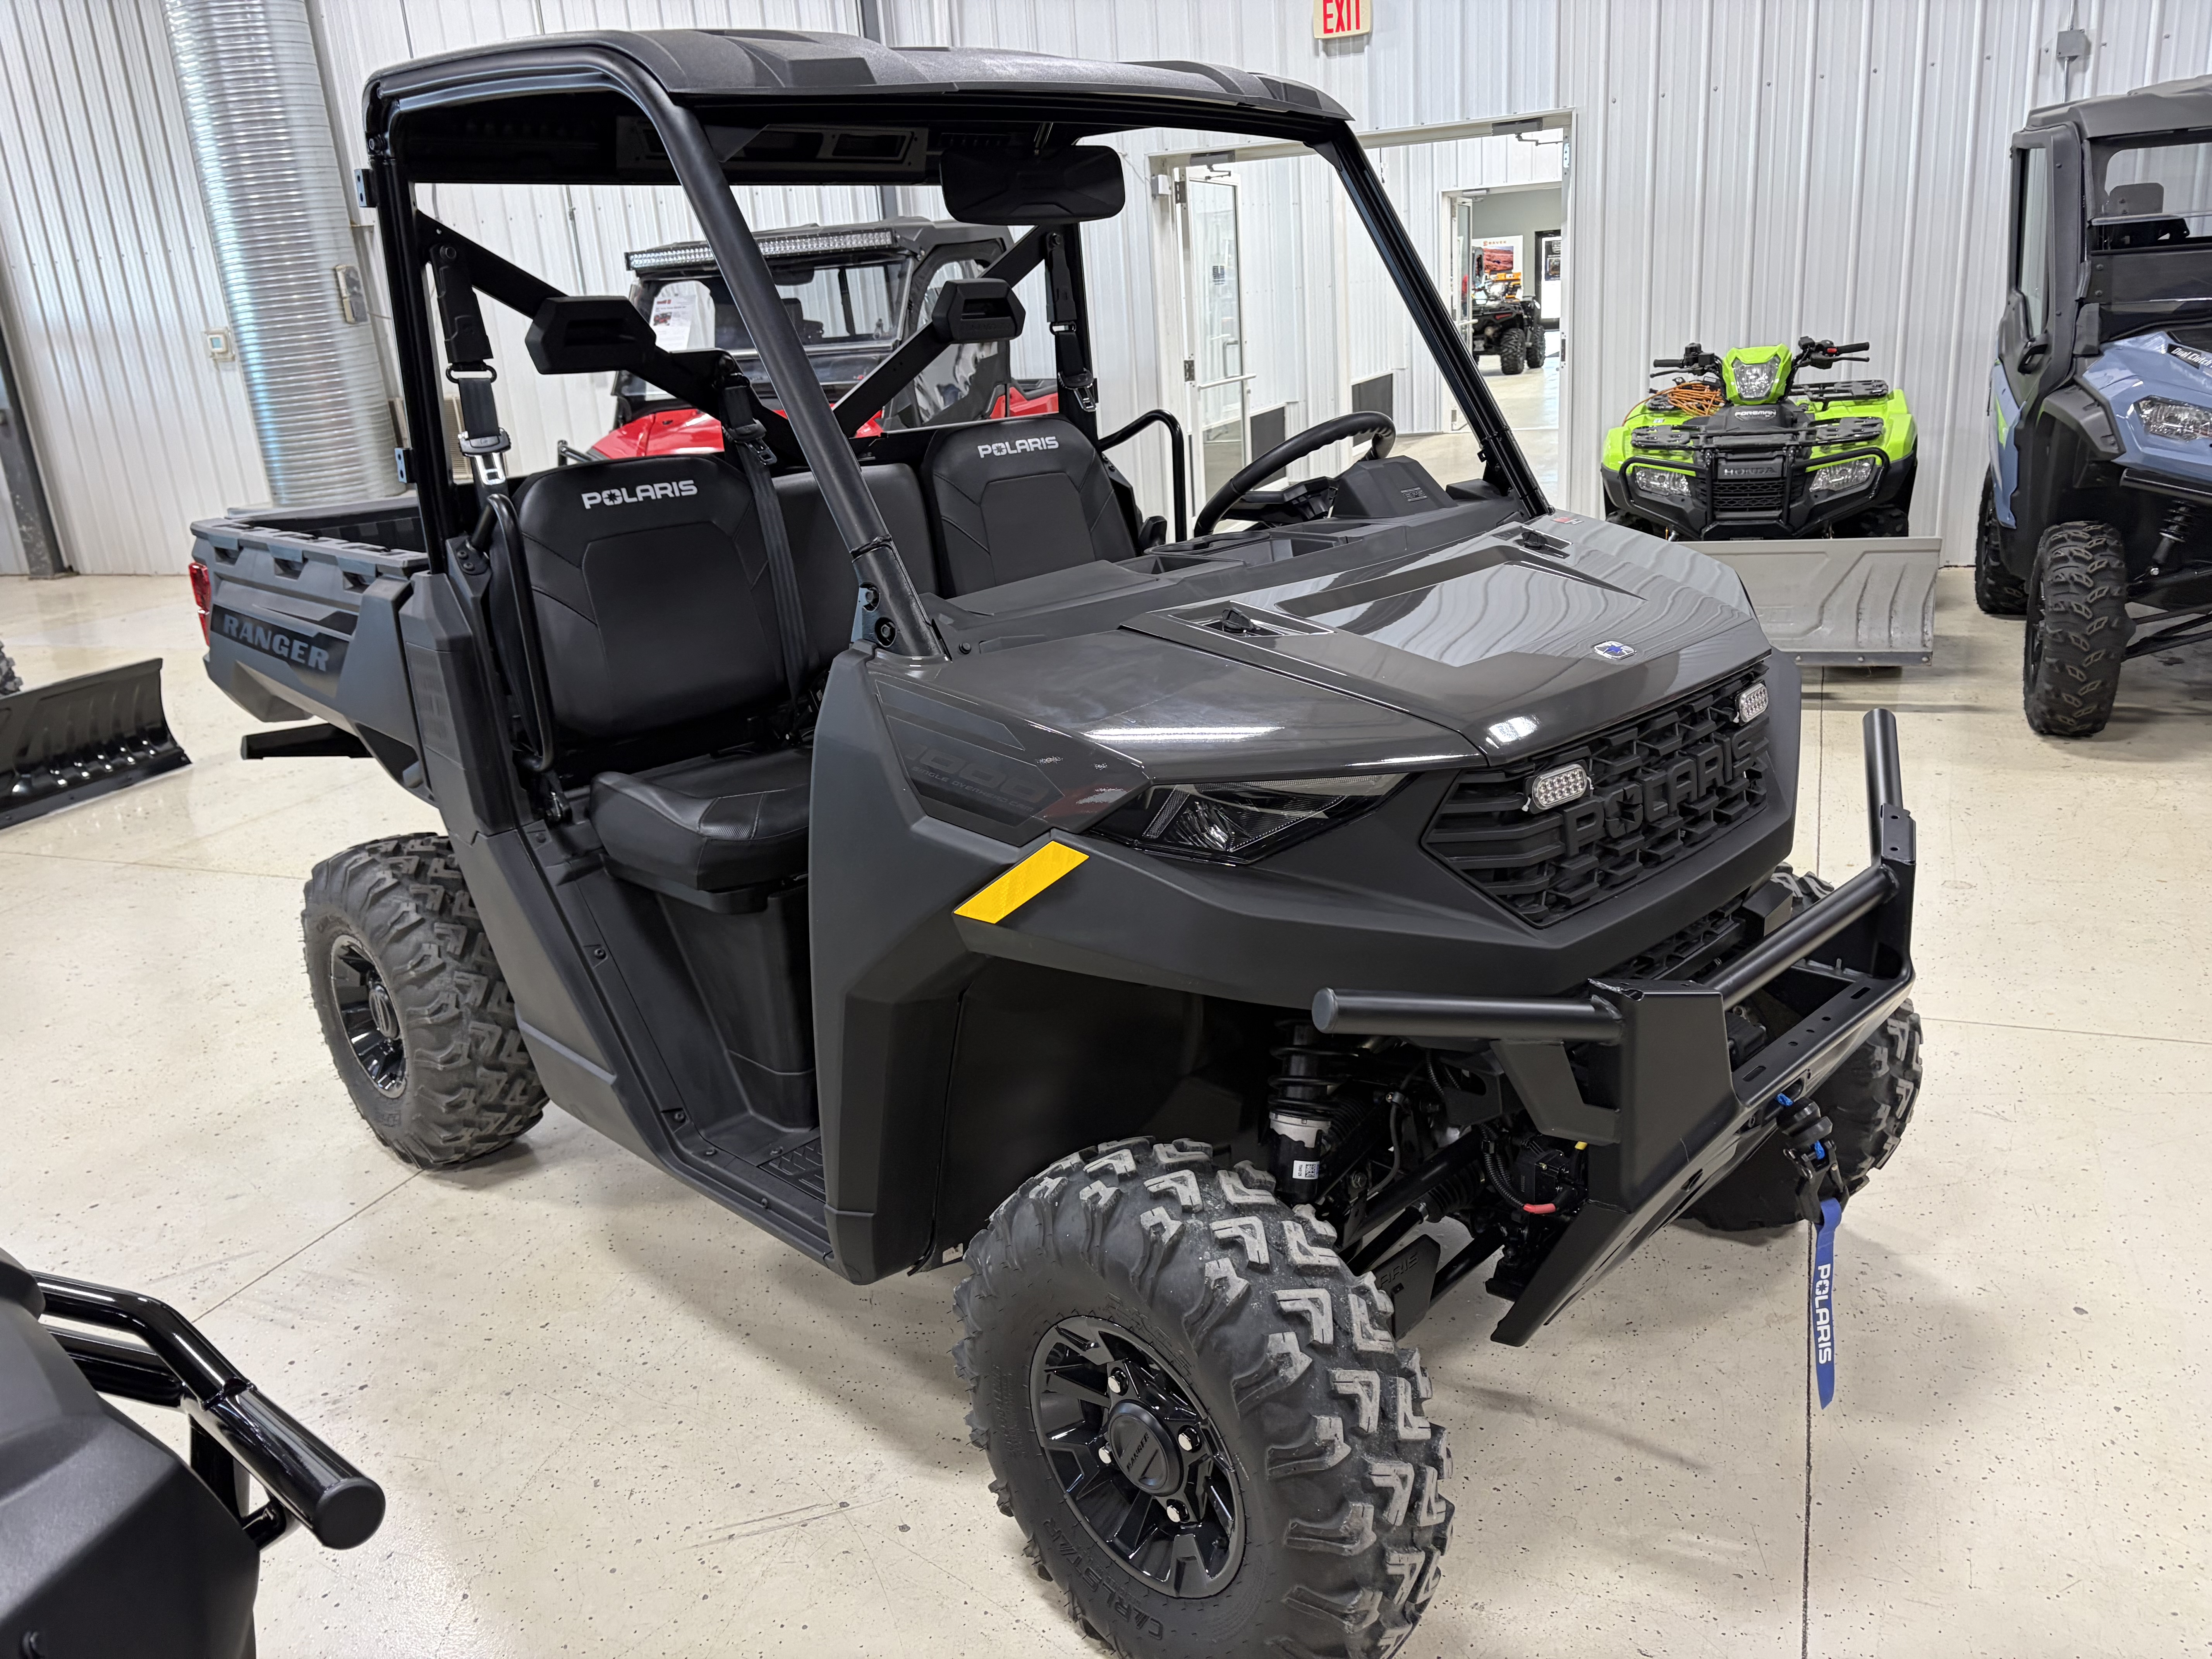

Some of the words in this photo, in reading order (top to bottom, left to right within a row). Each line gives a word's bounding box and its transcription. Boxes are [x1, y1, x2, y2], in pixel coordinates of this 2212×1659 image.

[1323, 0, 1360, 34] EXIT
[2171, 347, 2192, 359] Dual
[977, 436, 1059, 458] POLARIS
[1723, 467, 1778, 475] HONDA
[581, 480, 697, 509] POLARIS
[1403, 489, 1425, 499] EPS
[223, 614, 329, 672] RANGER
[905, 743, 1049, 803] 1000
[911, 766, 948, 783] SINGLE
[951, 780, 1008, 802] OVERHEAD
[1008, 800, 1034, 812] CAM
[1563, 725, 1755, 857] POLARIS
[1815, 1263, 1832, 1364] POLARIS
[1126, 1432, 1149, 1472] RANGER
[1043, 1517, 1164, 1640] CARLSTAR
